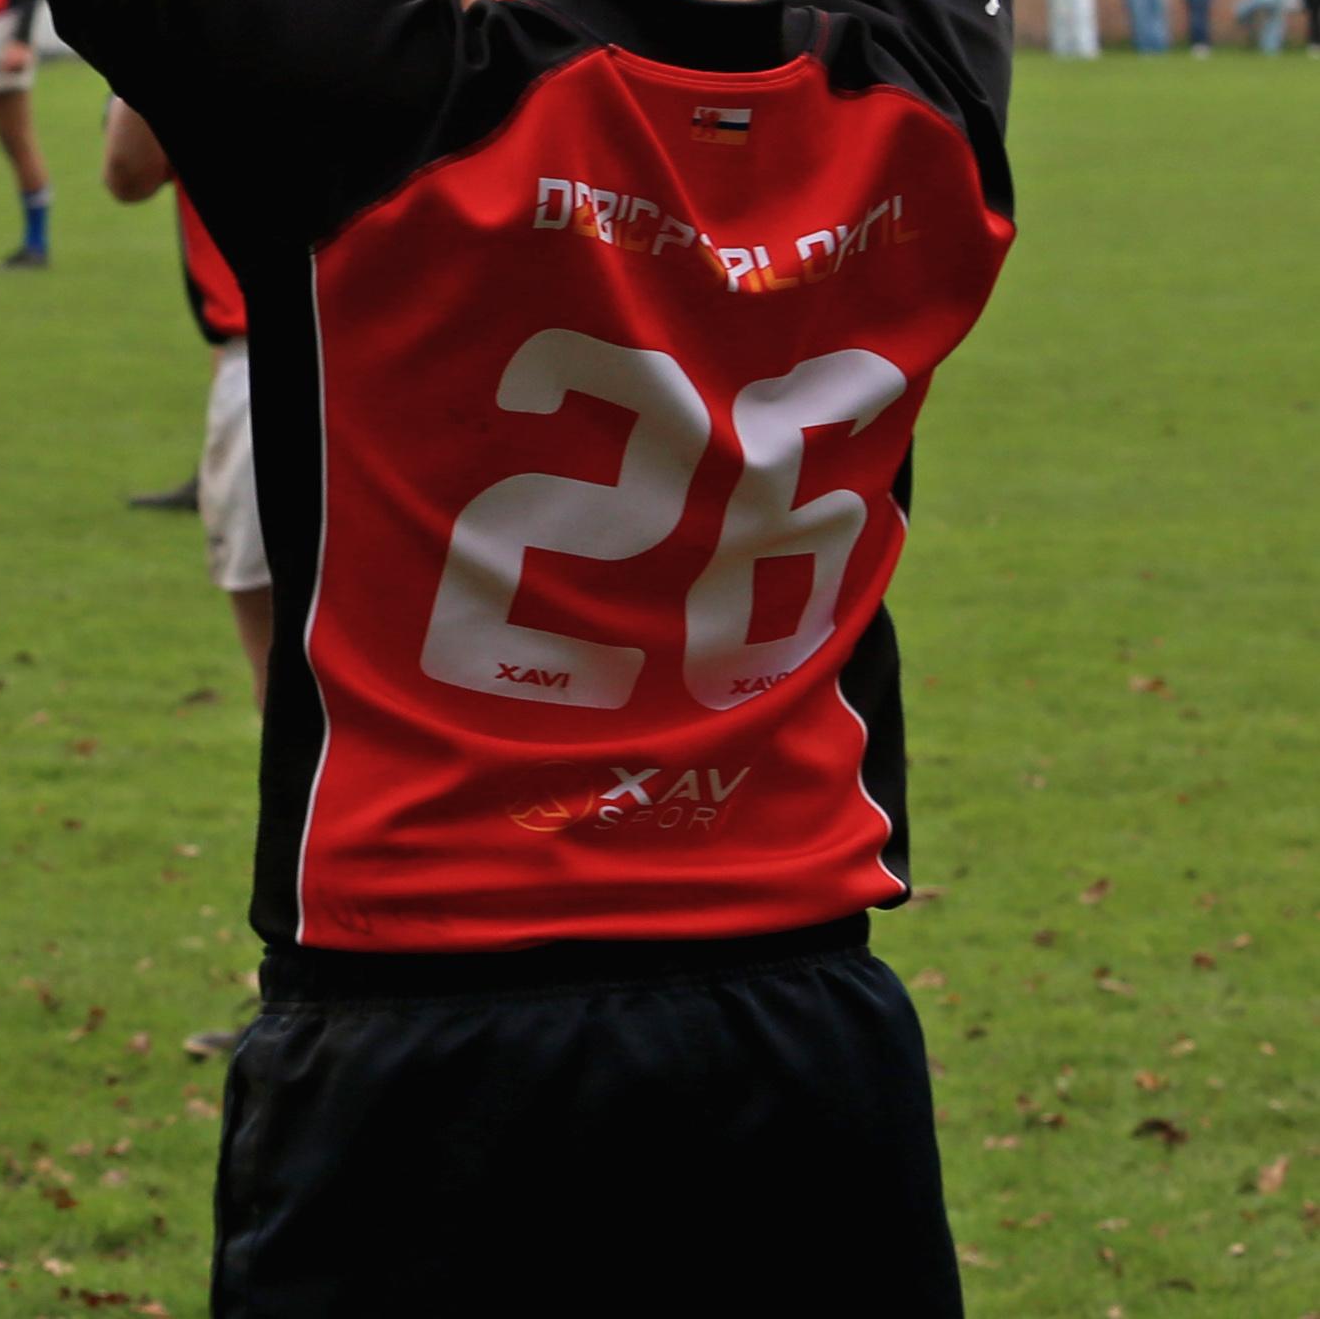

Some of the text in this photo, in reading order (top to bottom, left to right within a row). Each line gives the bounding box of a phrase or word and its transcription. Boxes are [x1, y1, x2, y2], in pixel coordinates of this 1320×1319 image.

[419, 327, 907, 710] 26
[494, 662, 571, 689] XAVI
[600, 766, 752, 806] XAV
[594, 805, 720, 831] SPOR
